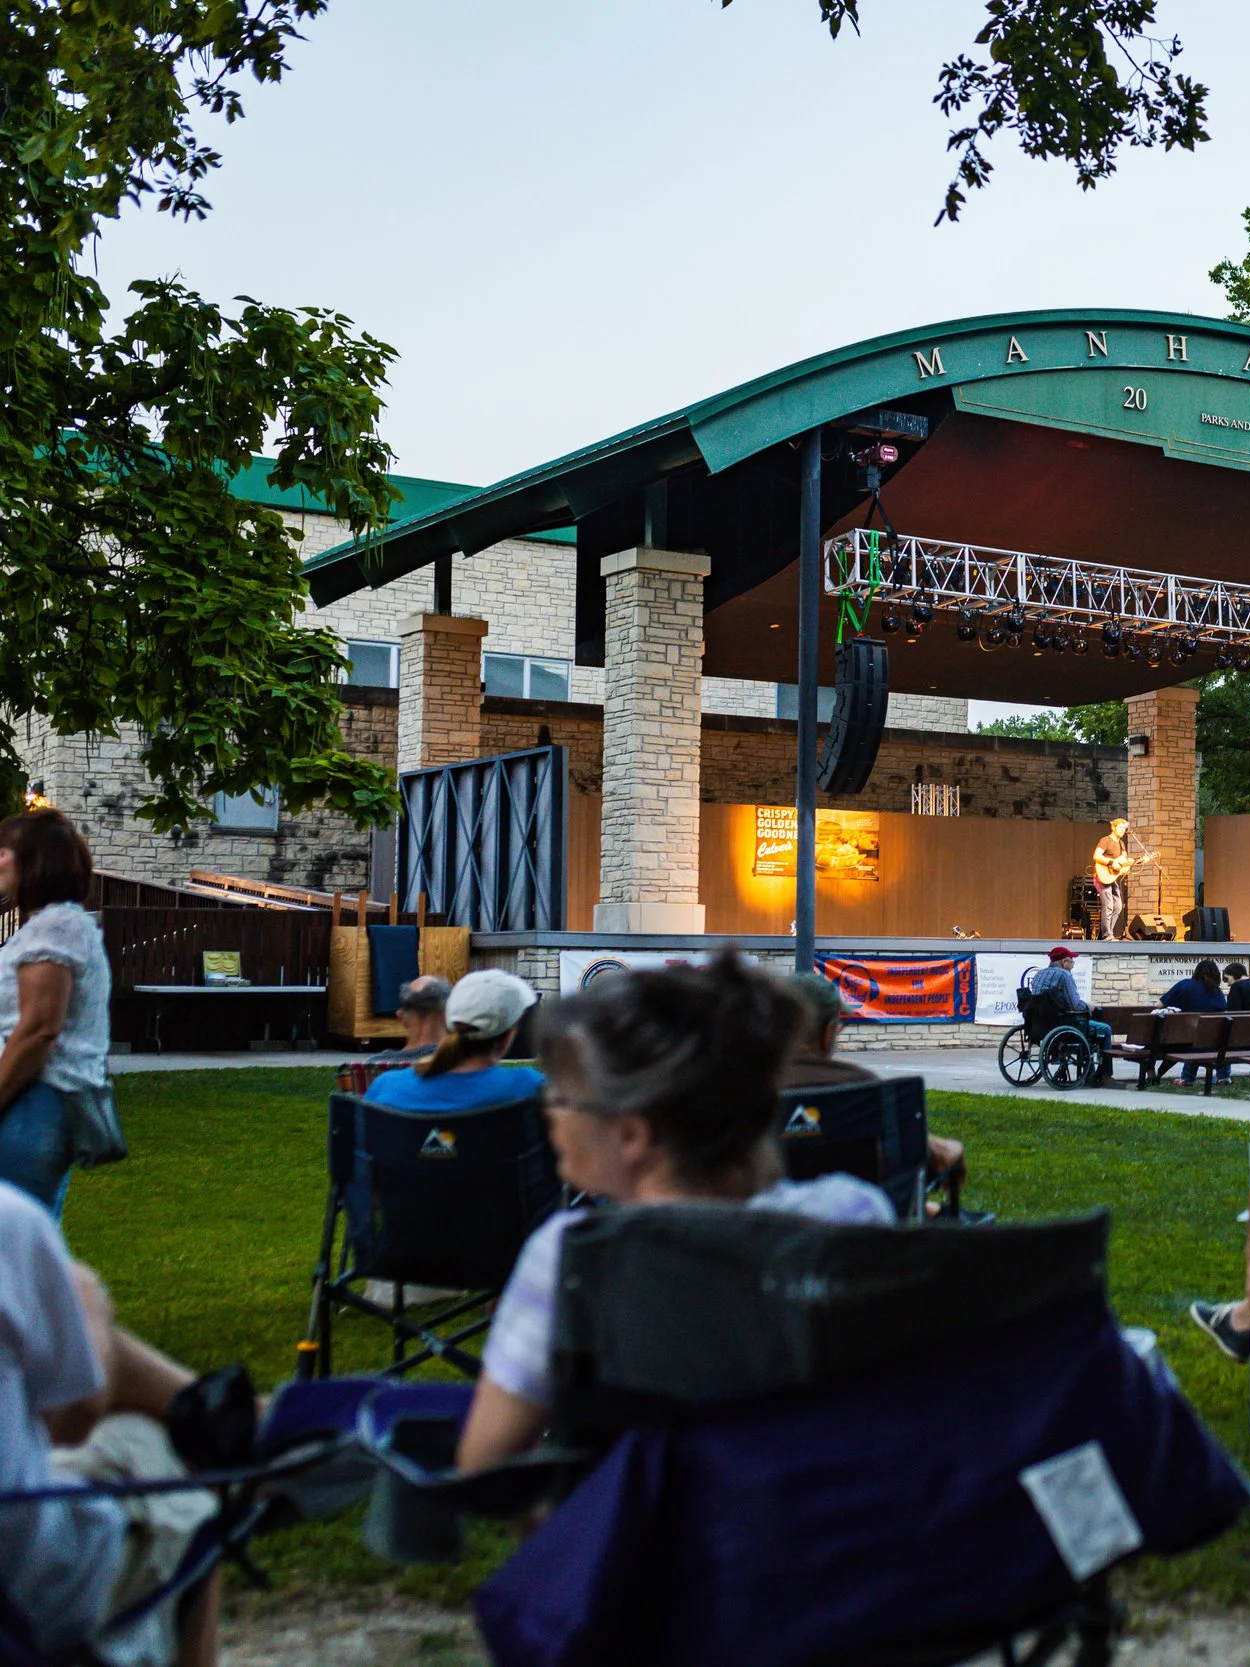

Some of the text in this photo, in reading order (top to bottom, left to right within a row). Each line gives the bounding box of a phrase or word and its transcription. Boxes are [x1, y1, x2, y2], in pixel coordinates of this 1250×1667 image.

[1122, 385, 1148, 411] 20
[1201, 413, 1229, 426] PARKS
[1230, 419, 1250, 431] AND
[757, 808, 794, 819] CRISPY
[757, 818, 798, 829] GOLDEN
[757, 828, 798, 839] GOODNE
[957, 960, 971, 1016] MUSIC
[994, 1001, 1017, 1011] EPOX
